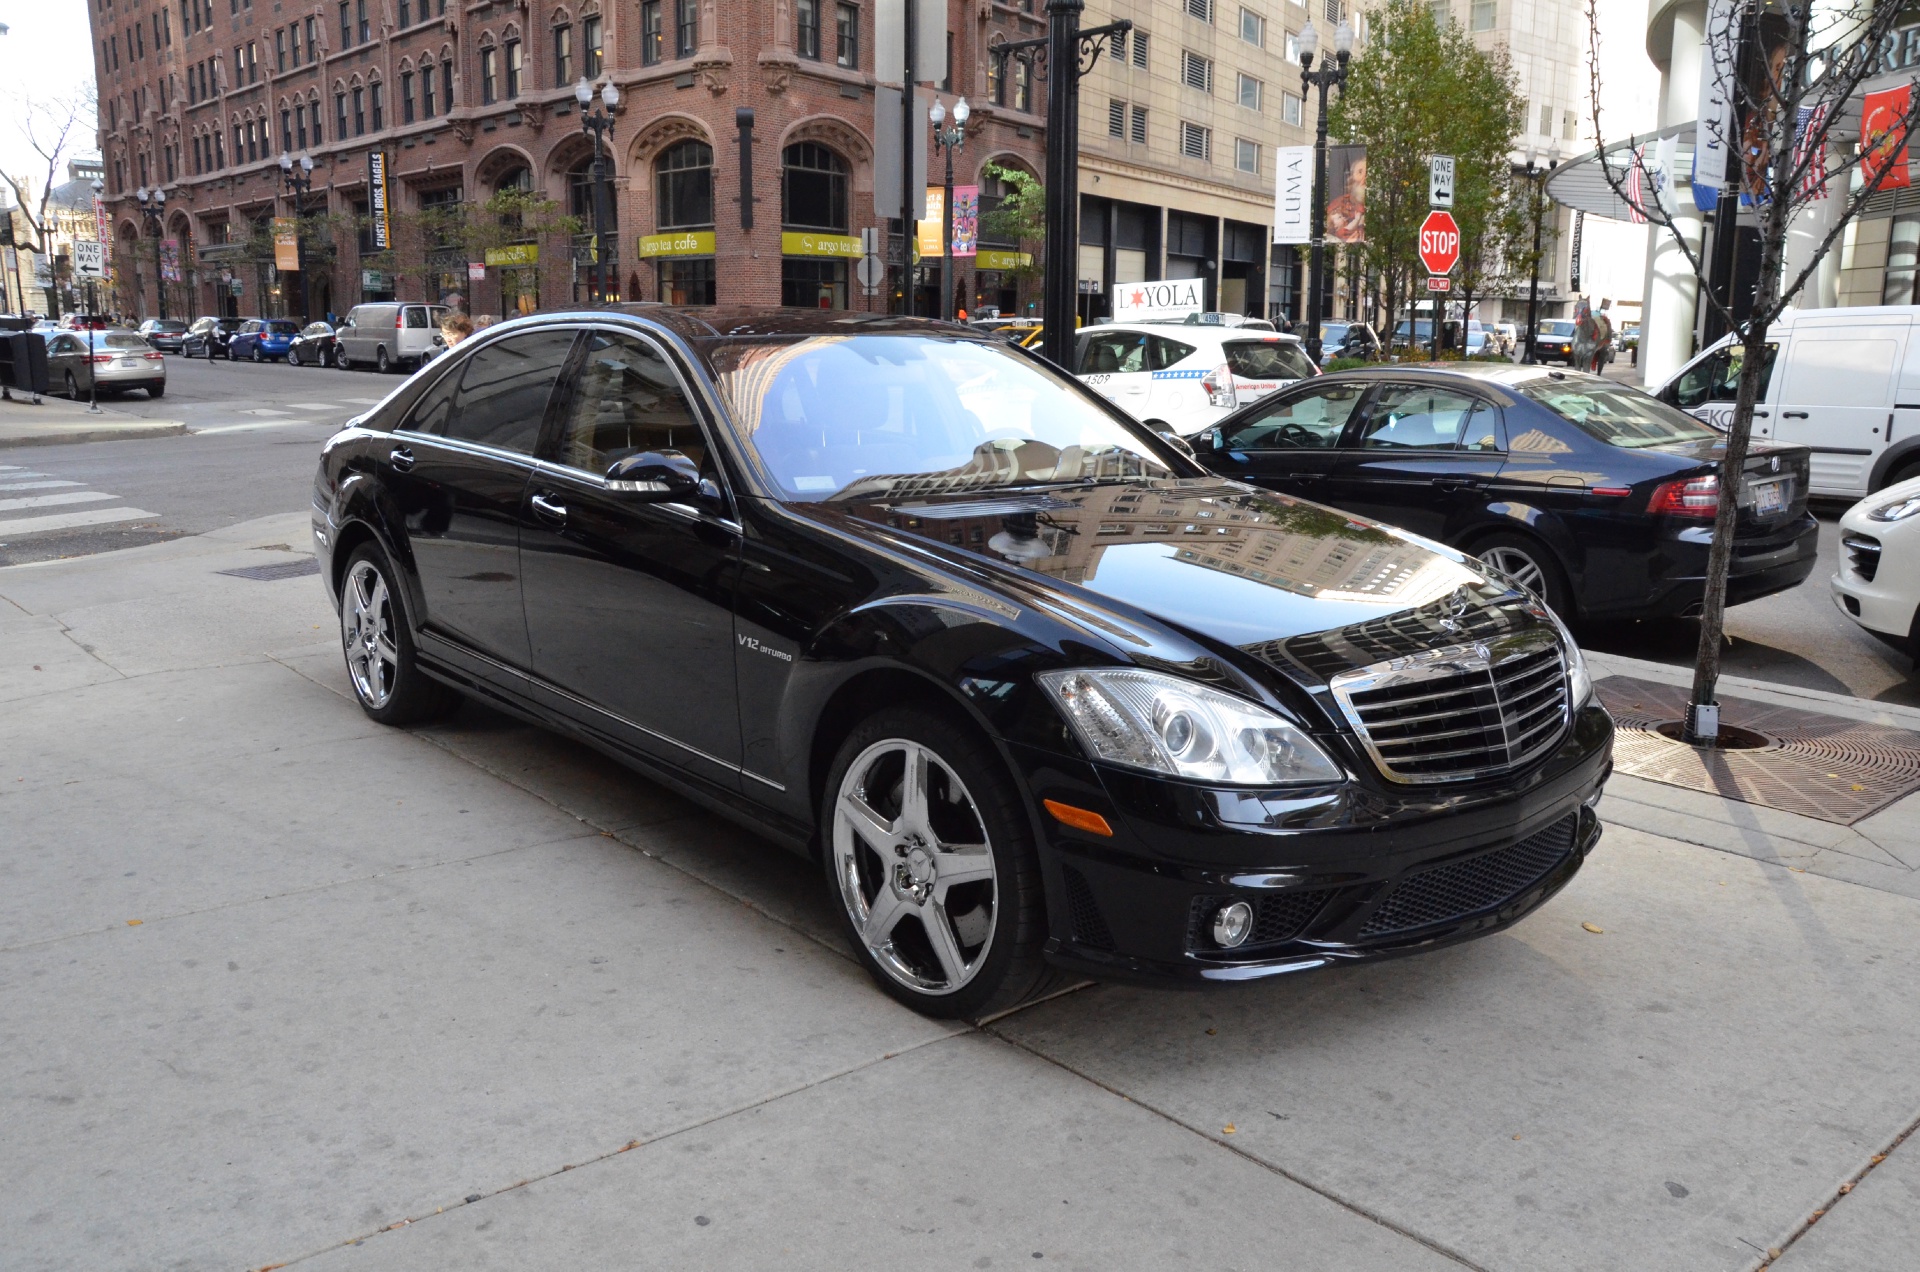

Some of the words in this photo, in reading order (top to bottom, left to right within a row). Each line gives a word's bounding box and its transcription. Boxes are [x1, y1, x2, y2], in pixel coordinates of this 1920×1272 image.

[371, 153, 383, 185] BAGELS
[1434, 159, 1452, 172] ONE
[1433, 173, 1452, 186] WAY
[373, 187, 384, 209] BROS.
[1284, 158, 1303, 224] LUMA
[96, 199, 110, 275] HERSHEYS
[375, 211, 387, 247] EINSTEIN
[1572, 210, 1582, 255] ORDSTROM
[77, 244, 100, 254] ONE
[660, 240, 672, 251] tea
[674, 234, 697, 250] café
[817, 241, 839, 255] argo
[840, 241, 851, 253] tea
[1422, 230, 1457, 255] STOP
[77, 254, 100, 263] WAY
[1439, 281, 1448, 289] WAY
[1205, 314, 1219, 325] 4509
[1084, 374, 1111, 385] 4509
[738, 633, 760, 650] V12
[760, 645, 792, 662] BITURBO
